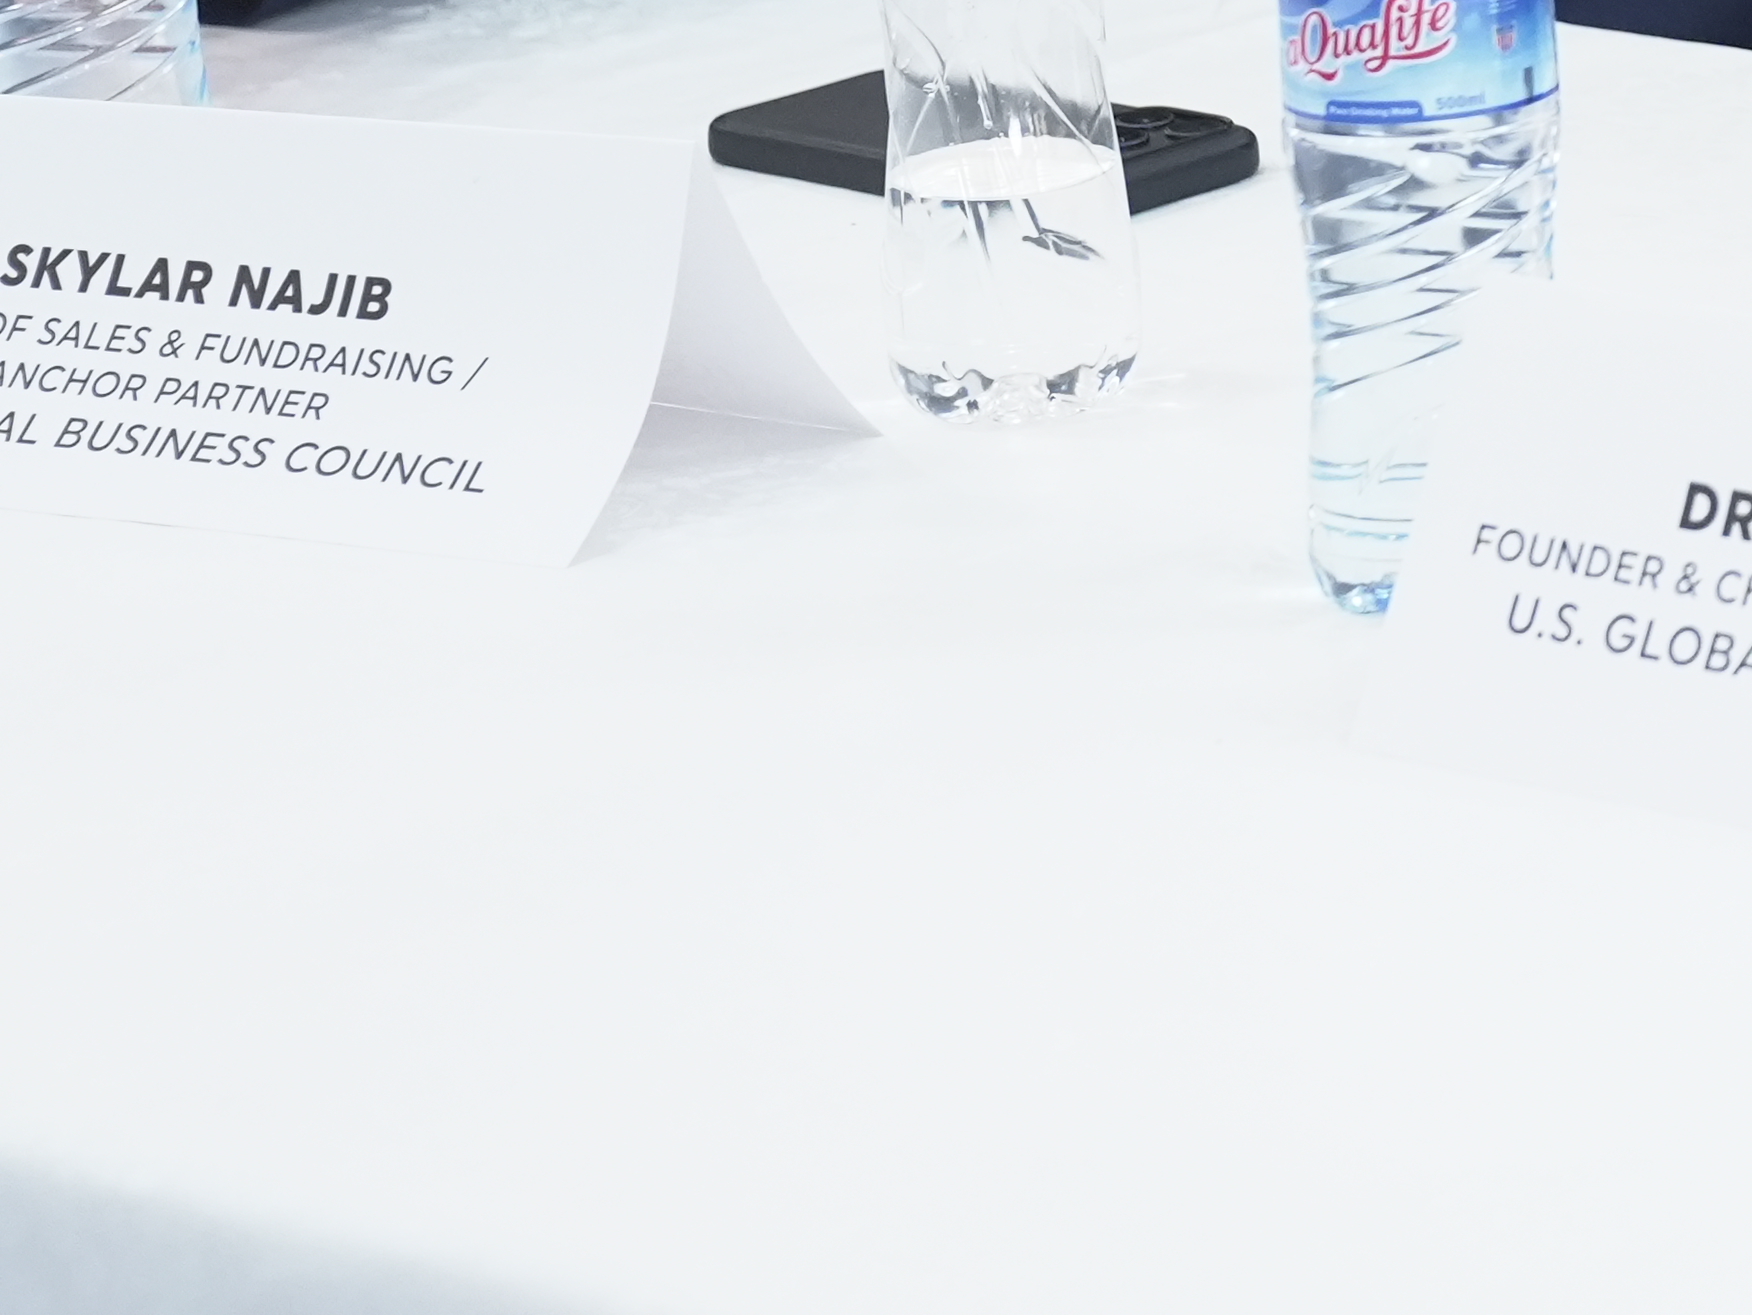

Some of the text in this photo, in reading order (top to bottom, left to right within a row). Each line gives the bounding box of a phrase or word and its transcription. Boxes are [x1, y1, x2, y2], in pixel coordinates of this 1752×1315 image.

[0, 244, 392, 320] SKYLAR NAJIB
[0, 312, 34, 342] F
[37, 317, 152, 355] SALES
[159, 329, 186, 359] &
[195, 333, 454, 386] FUNDRAISING
[0, 360, 330, 421] NCHOR PARTNER
[54, 417, 275, 469] BUSINESS
[285, 442, 485, 493] COUNCIL
[1471, 522, 1665, 590] FOUNDER
[1674, 561, 1701, 597] &
[1507, 592, 1586, 645] U.S.
